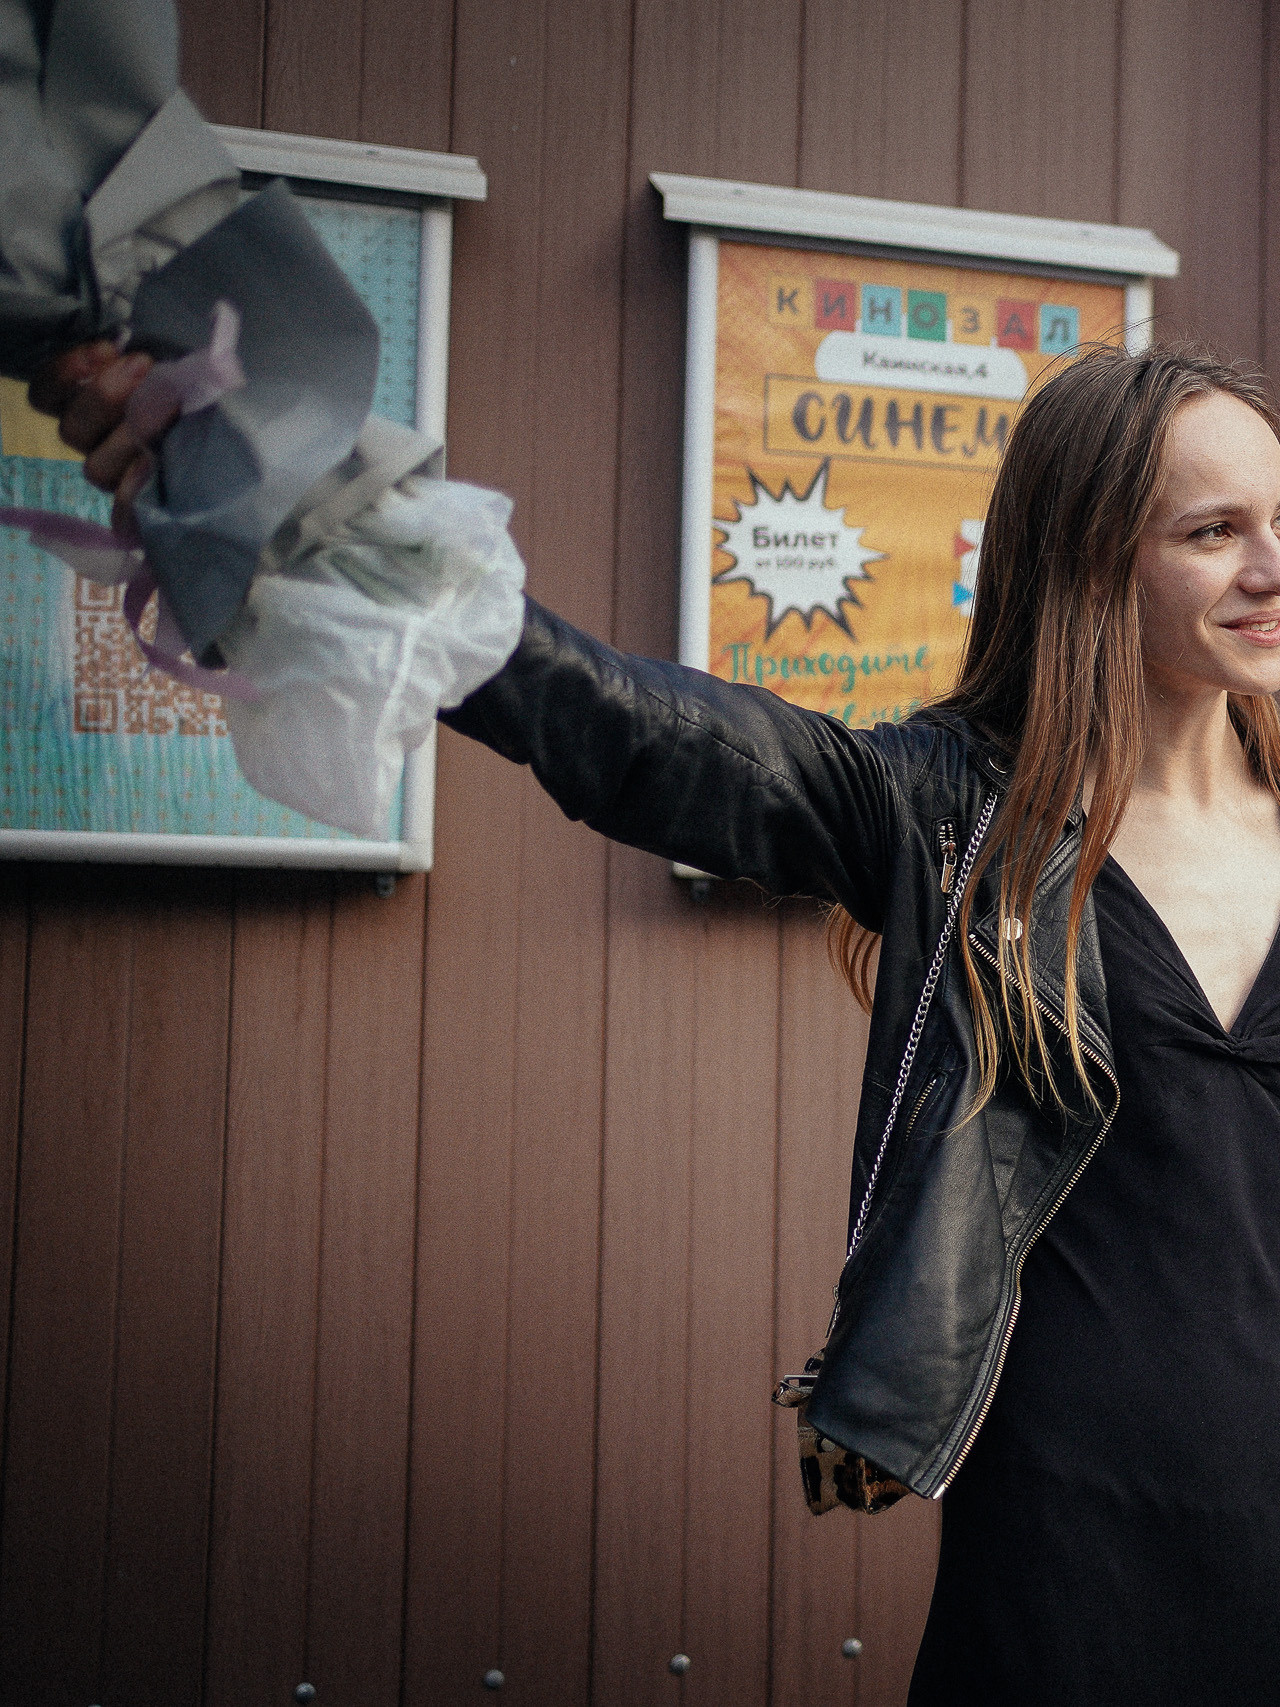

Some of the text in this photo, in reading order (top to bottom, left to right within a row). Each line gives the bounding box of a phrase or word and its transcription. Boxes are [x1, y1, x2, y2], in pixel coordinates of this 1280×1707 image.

[776, 287, 1071, 344] КИНОЗАЛ
[792, 391, 1010, 458] СИНЕМ
[752, 526, 839, 549] Билет
[722, 642, 932, 694] Приходите
